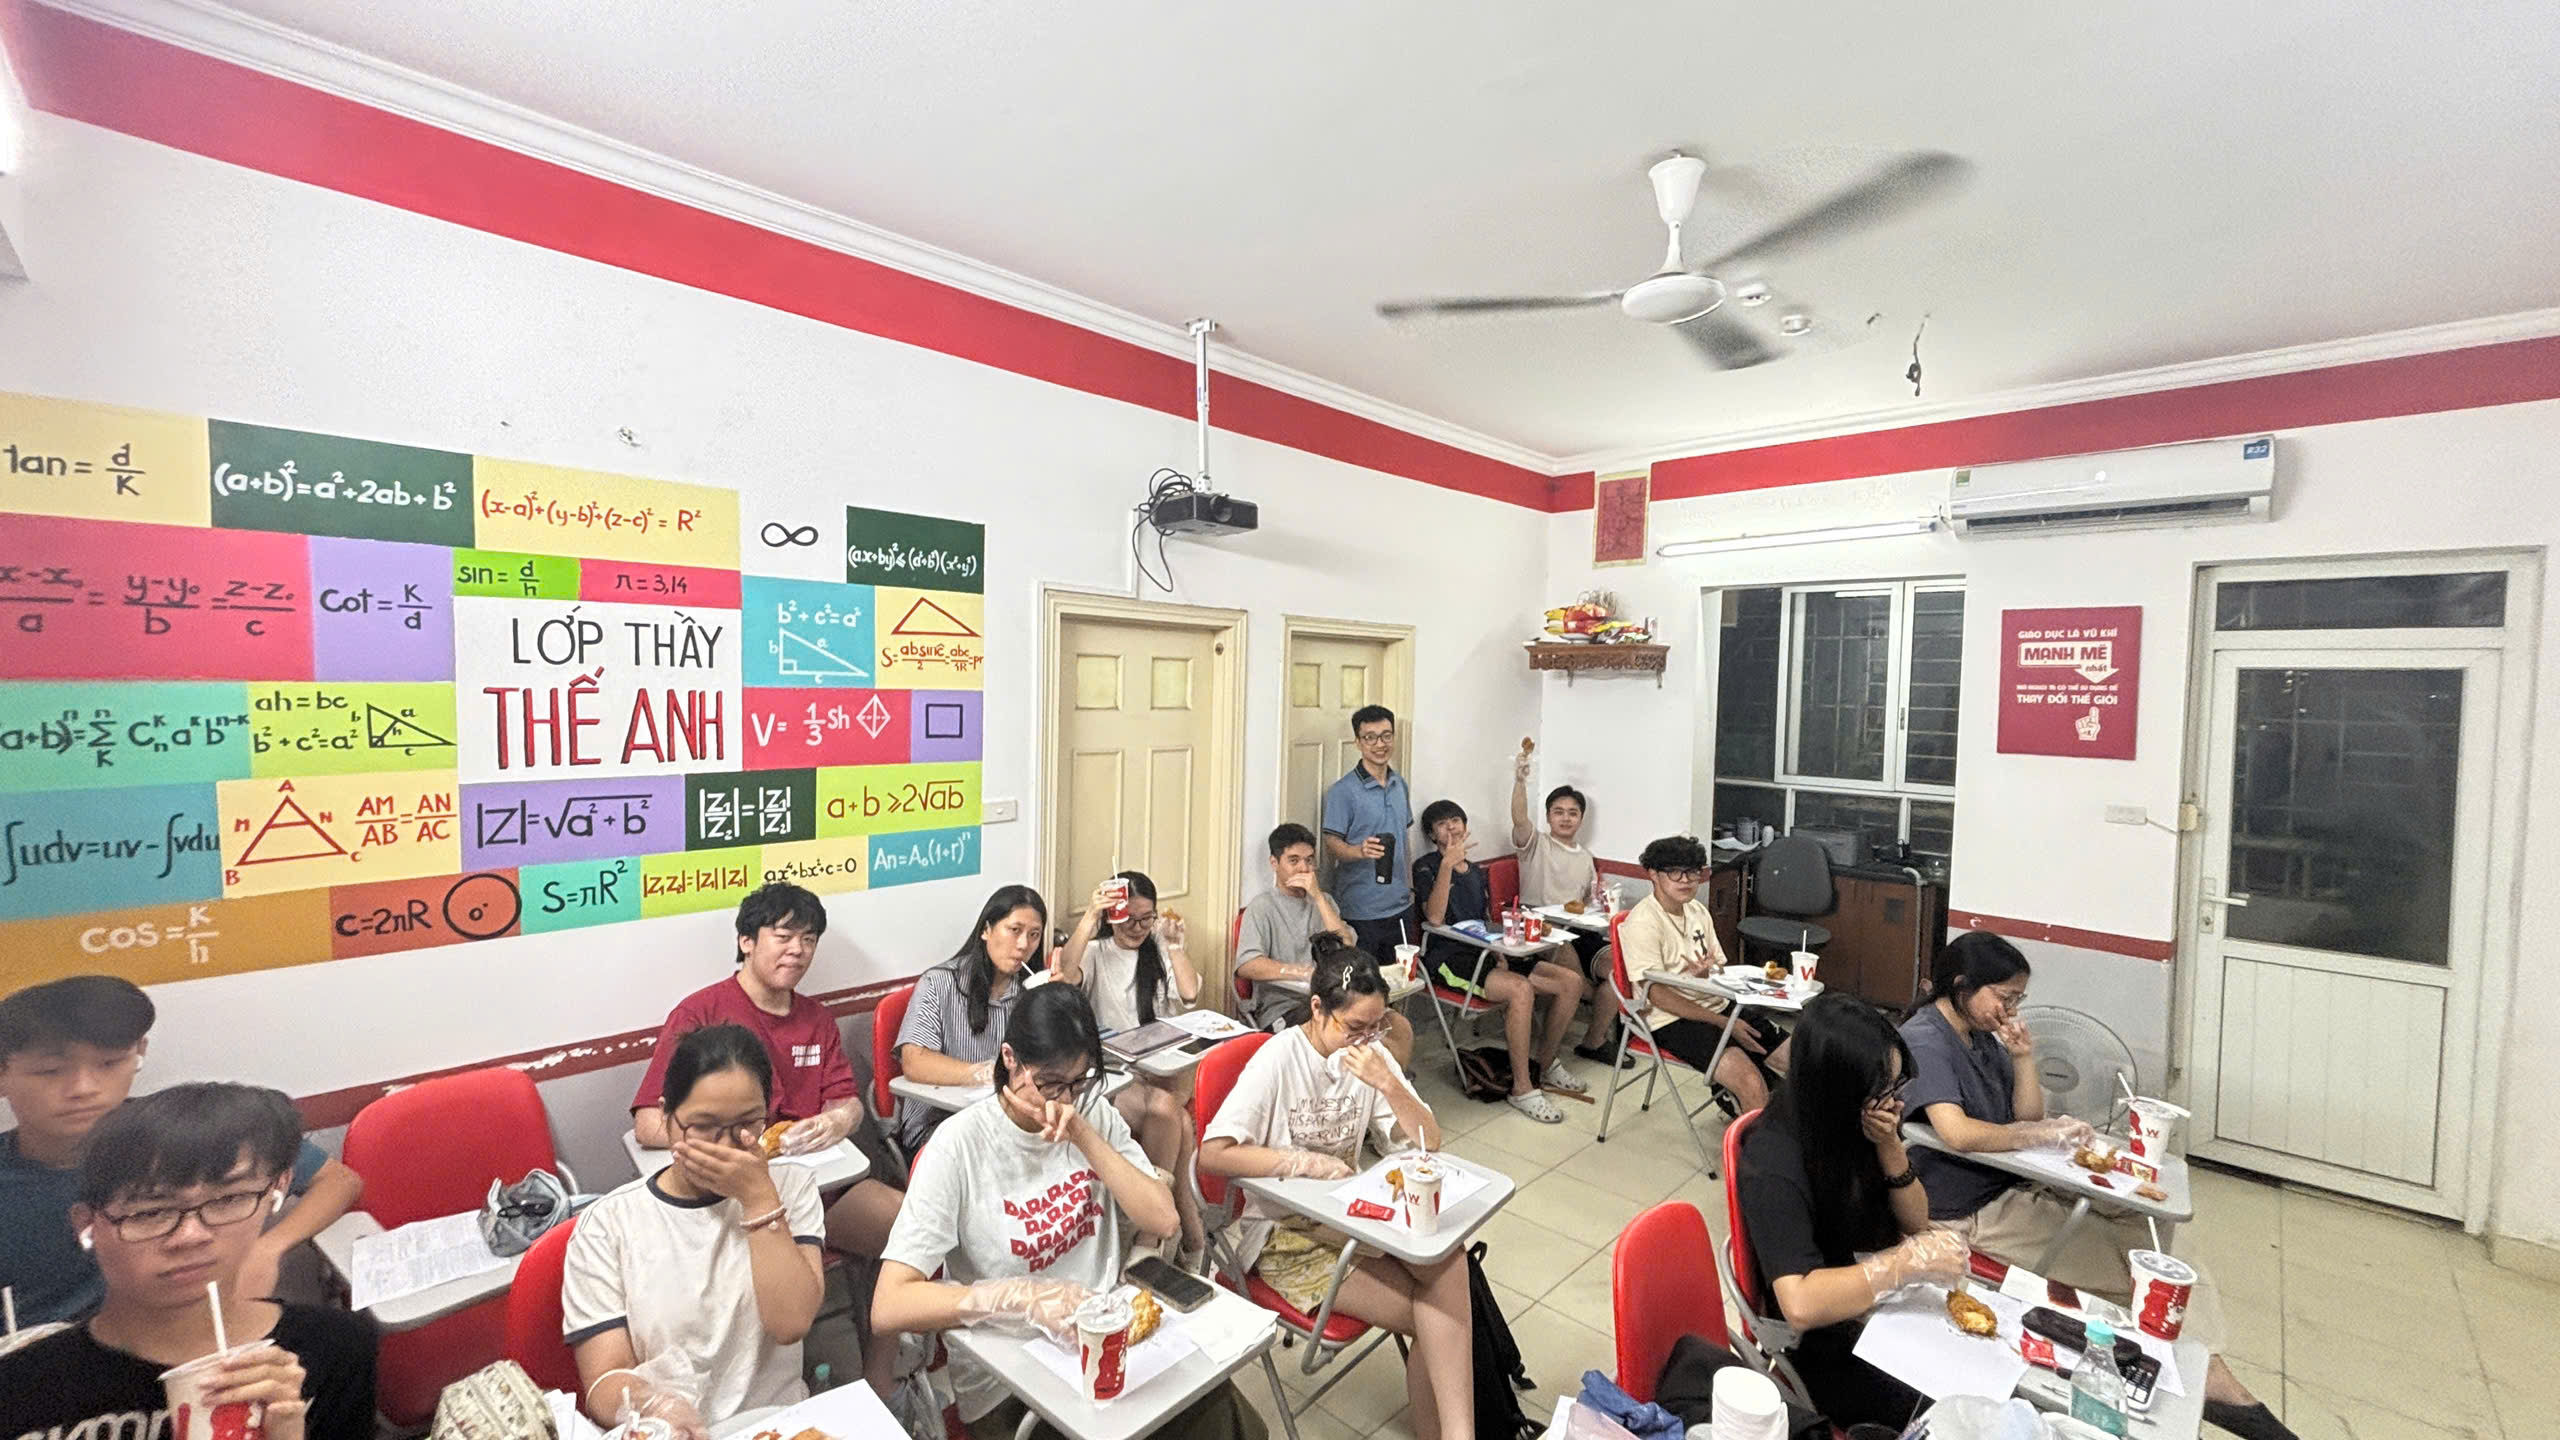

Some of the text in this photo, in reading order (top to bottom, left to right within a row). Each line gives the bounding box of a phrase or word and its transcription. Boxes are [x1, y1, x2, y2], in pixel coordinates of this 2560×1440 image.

[512, 605, 723, 669] LỚP THẦY
[2024, 646, 2075, 664] MẠNH
[483, 666, 724, 770] THẾ ANH
[2017, 693, 2045, 704] THAY
